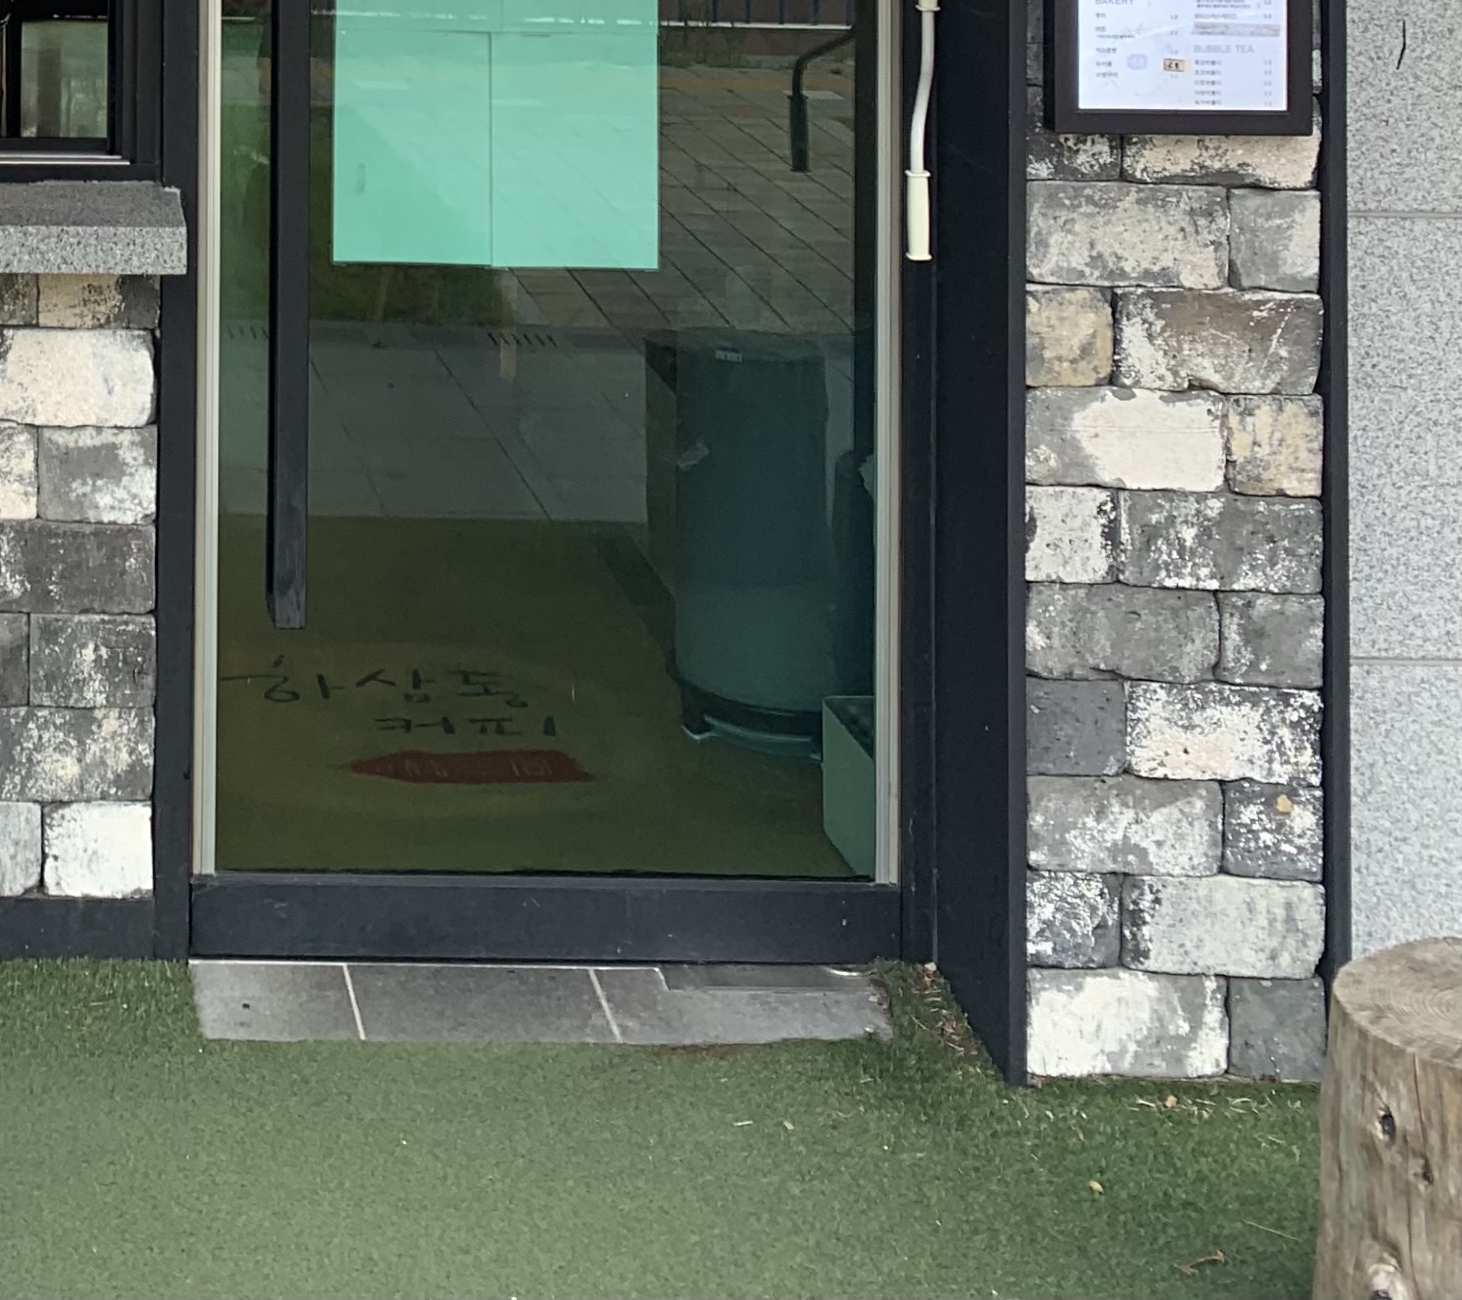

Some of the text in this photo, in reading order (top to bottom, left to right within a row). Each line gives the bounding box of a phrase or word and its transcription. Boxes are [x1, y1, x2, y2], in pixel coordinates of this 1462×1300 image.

[1194, 44, 1255, 53] BUBBLE TEA
[374, 715, 557, 736] 커피
